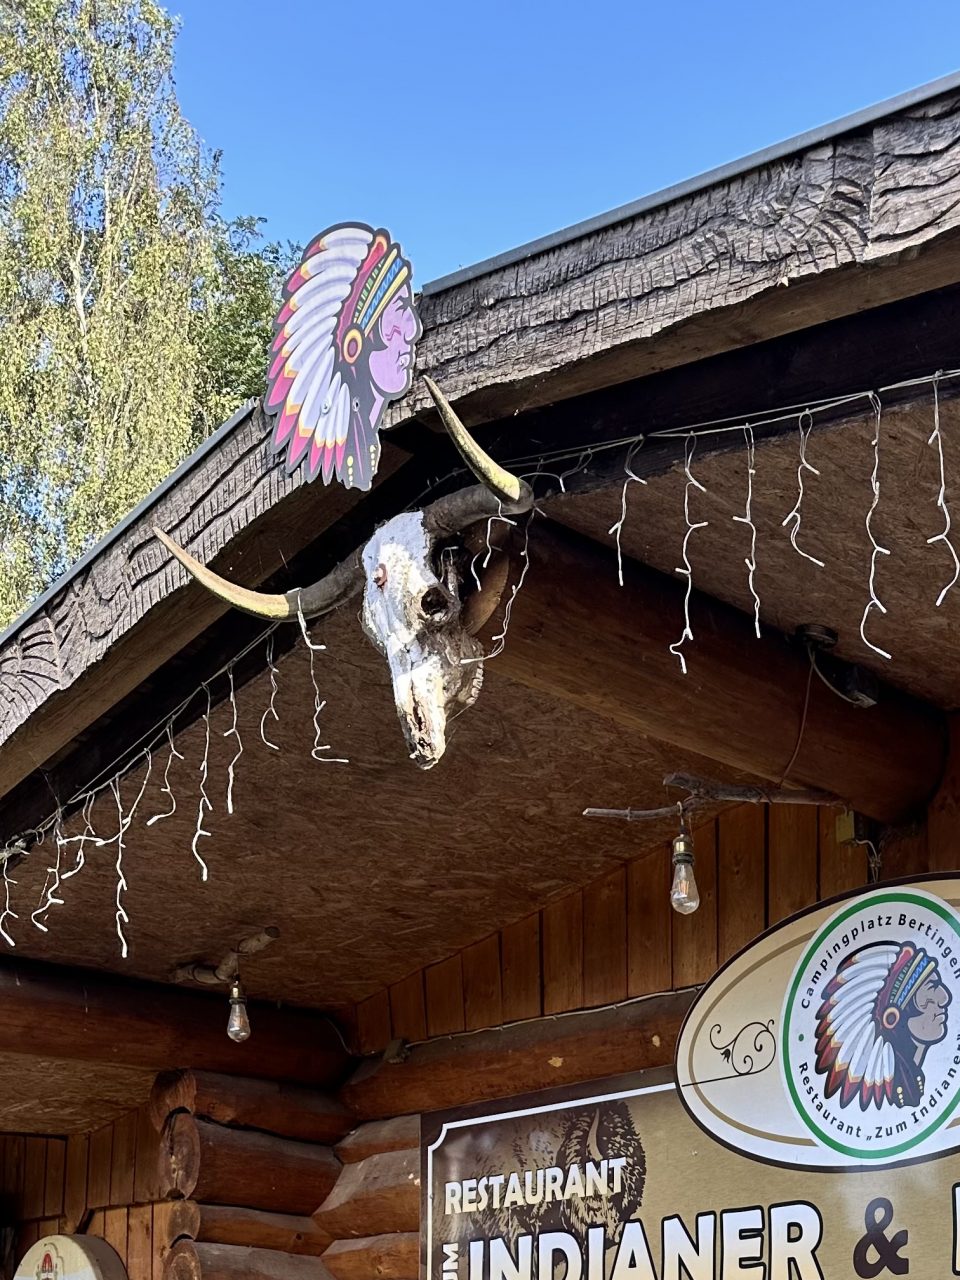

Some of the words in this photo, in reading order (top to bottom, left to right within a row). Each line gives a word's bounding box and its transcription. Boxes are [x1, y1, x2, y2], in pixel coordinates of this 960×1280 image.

[800, 914, 893, 1010] Campingplatz
[799, 1061, 862, 1139] Restaurant
[444, 1157, 627, 1215] RESTAURANT
[853, 1197, 909, 1279] &
